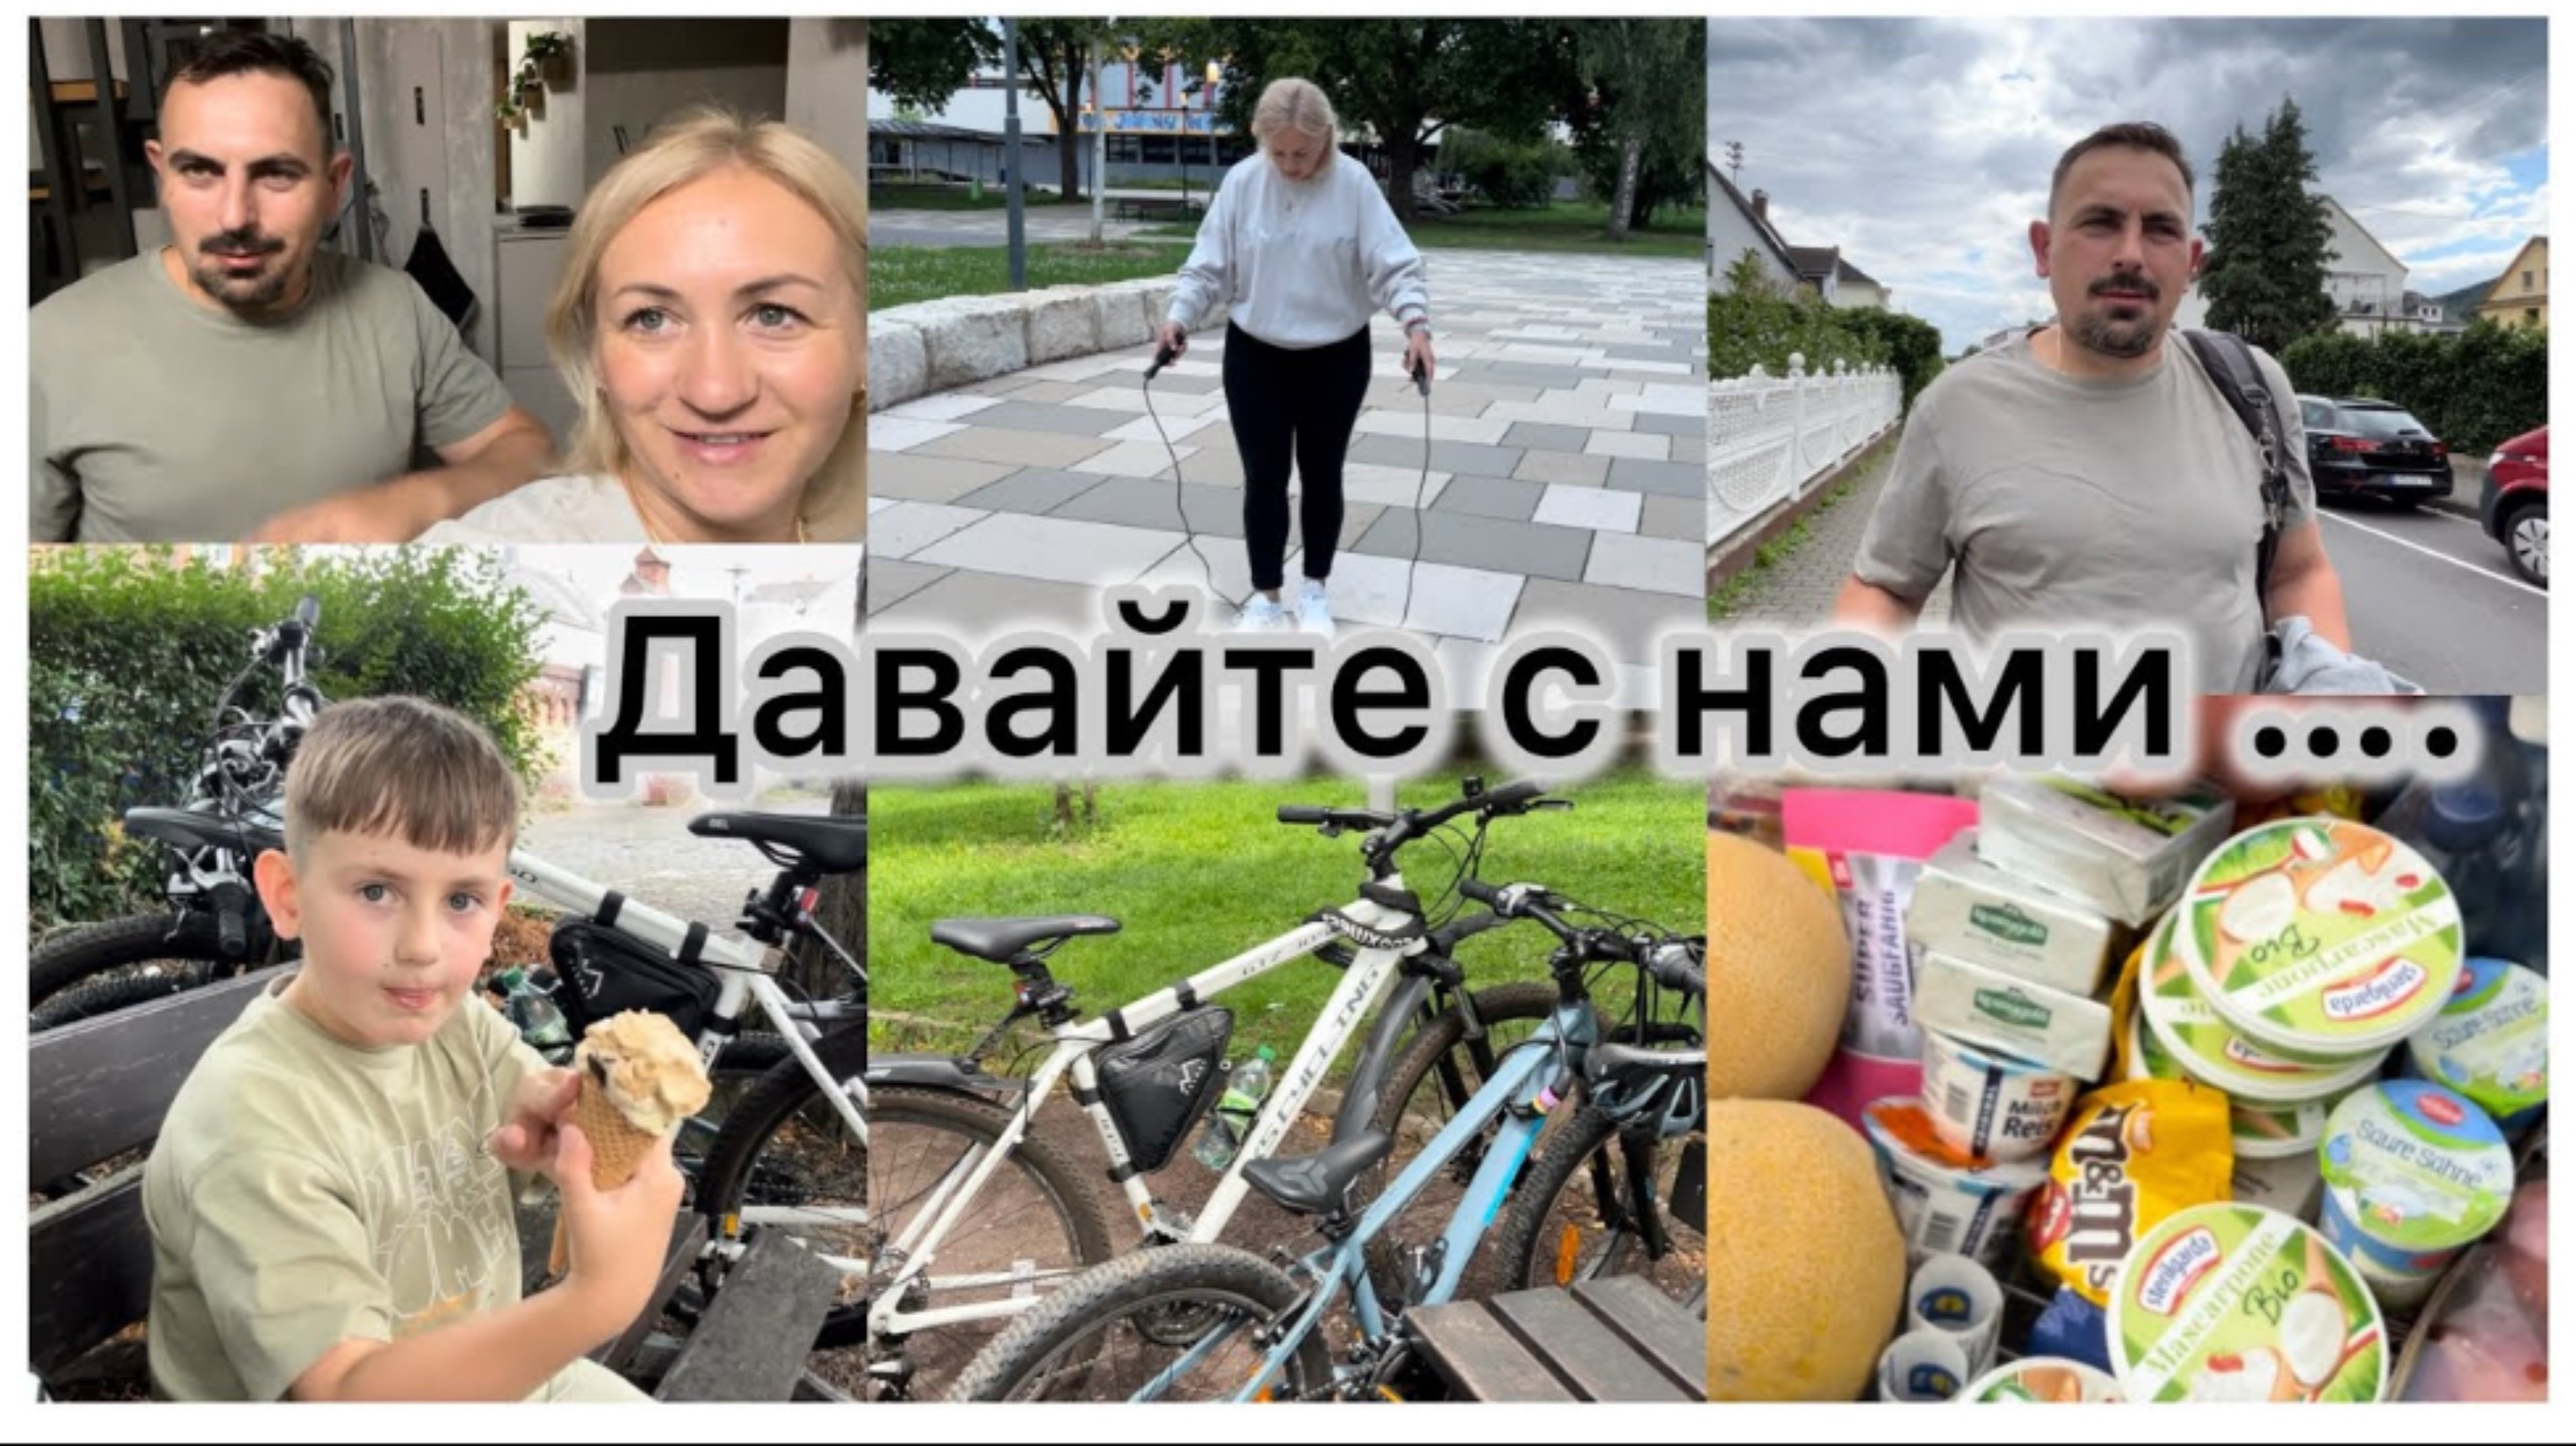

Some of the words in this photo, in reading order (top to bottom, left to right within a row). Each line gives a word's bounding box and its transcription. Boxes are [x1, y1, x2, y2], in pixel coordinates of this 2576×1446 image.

[1855, 900, 1875, 1004] SUPER
[2257, 914, 2437, 1000] Mascarpone
[2357, 1119, 2414, 1161] Saure
[2416, 1147, 2483, 1190] Sahne
[2147, 1231, 2275, 1373] Mascarpone
[2243, 1268, 2299, 1326] Bio
